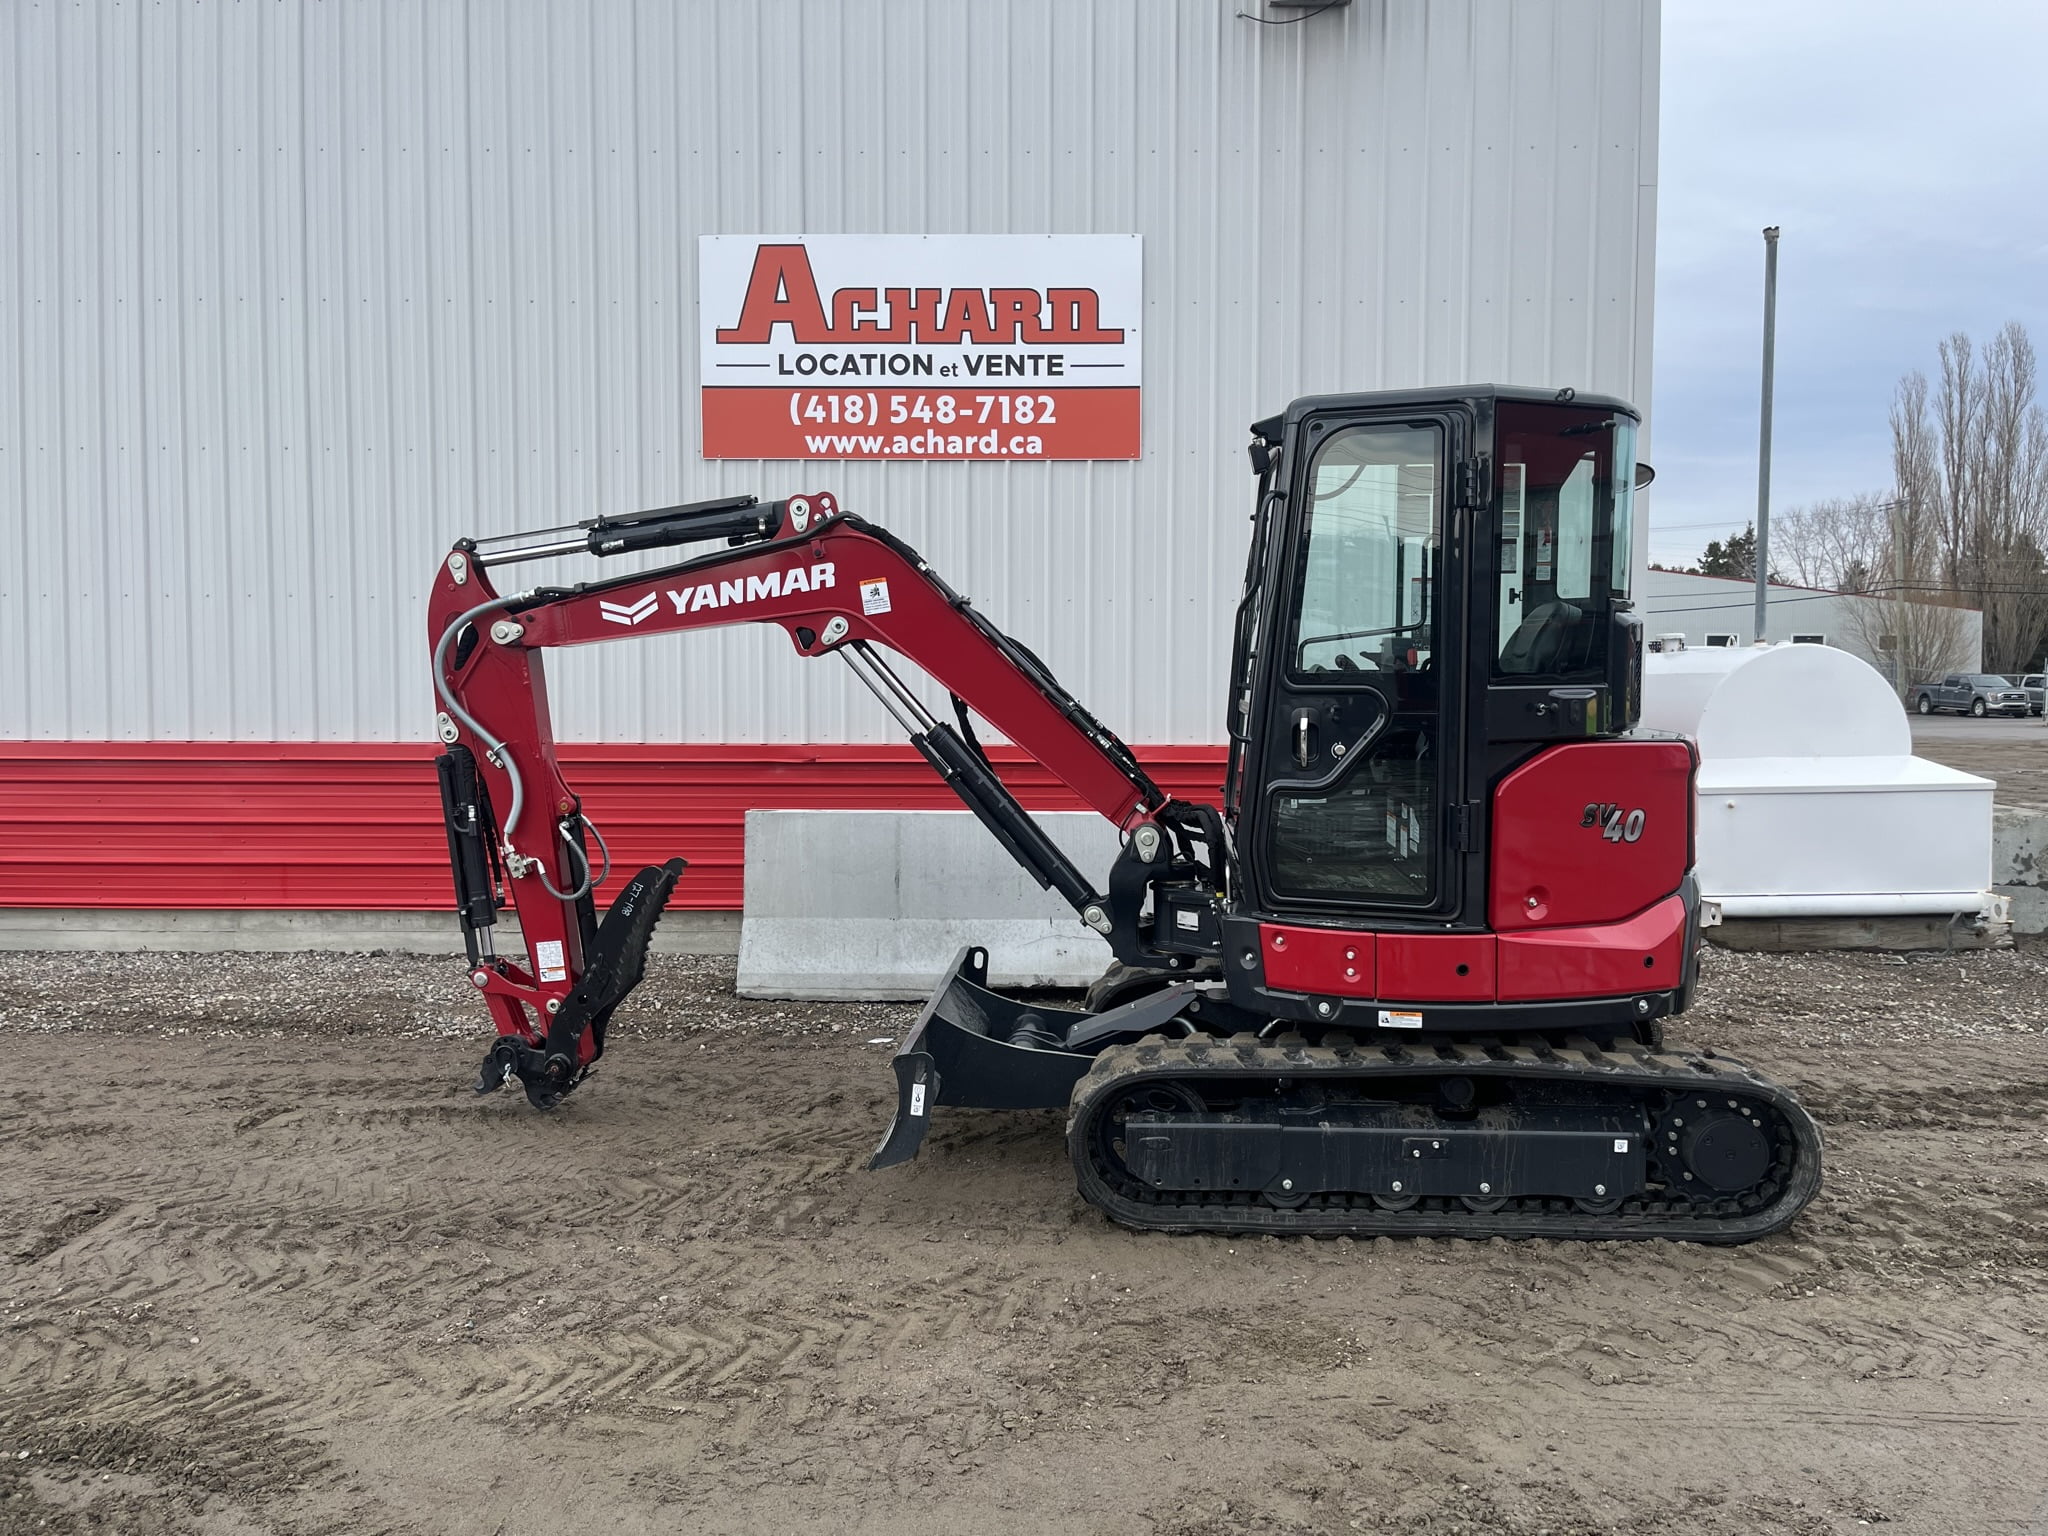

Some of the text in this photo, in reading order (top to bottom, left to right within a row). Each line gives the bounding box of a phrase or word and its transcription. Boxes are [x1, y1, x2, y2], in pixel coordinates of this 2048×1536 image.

[715, 244, 1125, 344] ACHARD
[778, 353, 1064, 378] LOCATION et VENTE
[790, 392, 1057, 425] (418) 548-7182
[804, 429, 1043, 454] www.achard.ca
[666, 562, 836, 615] YANMAR
